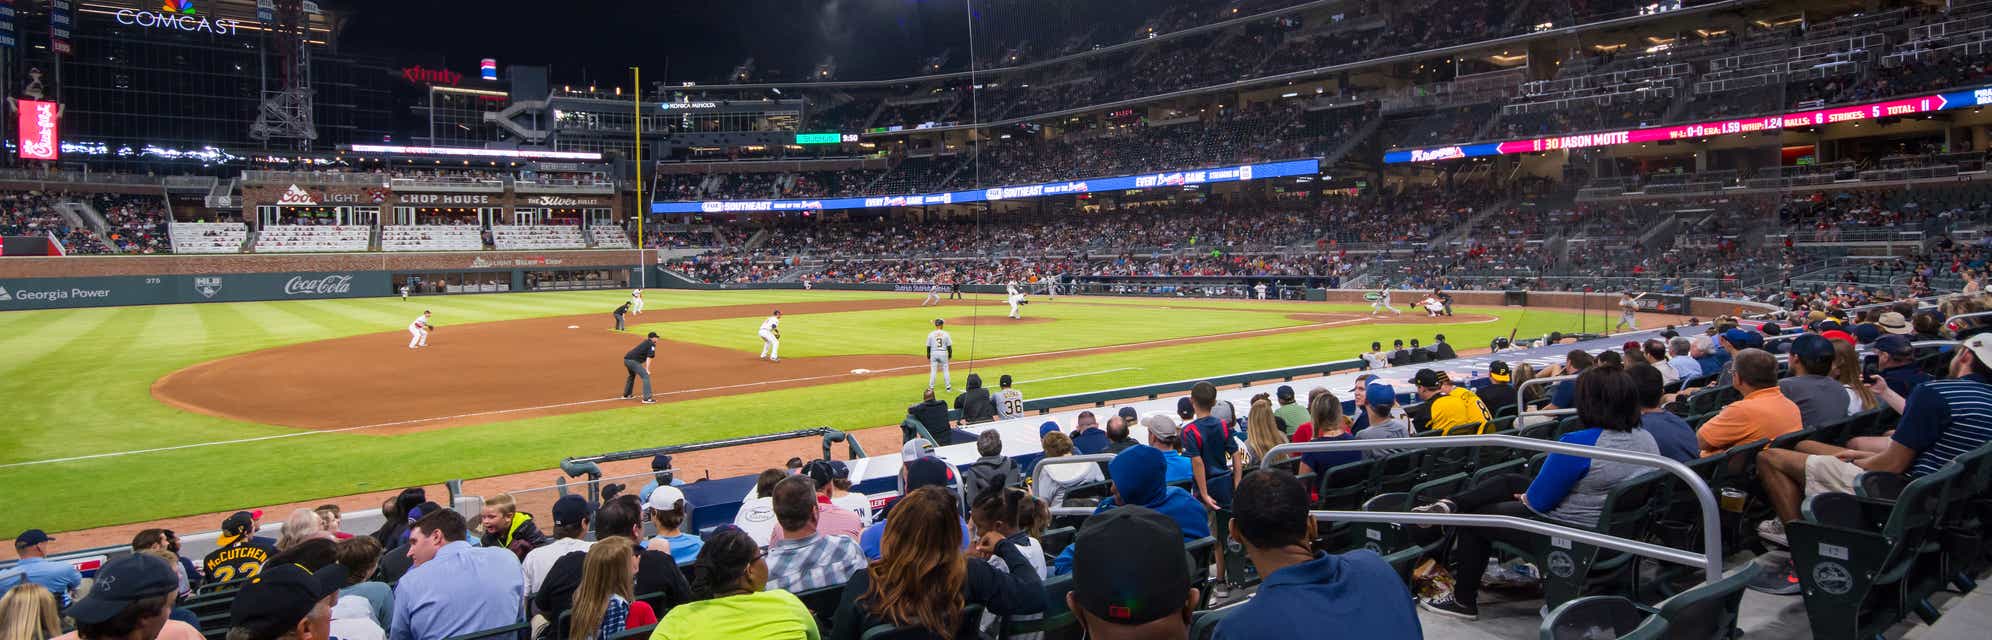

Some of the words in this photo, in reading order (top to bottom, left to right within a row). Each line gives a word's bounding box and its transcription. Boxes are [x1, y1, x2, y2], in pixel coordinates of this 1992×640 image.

[116, 10, 239, 35] COMCAST
[402, 65, 462, 86] xfinity
[1545, 137, 1559, 150] 30
[1561, 134, 1592, 149] JASON
[1593, 131, 1629, 147] MOTTE
[1687, 125, 1703, 137] 0-0
[1704, 127, 1720, 136] ERA:
[1722, 121, 1740, 134] 1.59
[1741, 122, 1764, 132] WHIP:
[1765, 118, 1782, 129] 1.24
[1784, 116, 1811, 127] BALLS:
[1816, 112, 1824, 124] 6
[1829, 111, 1865, 122] STRIKES:
[1872, 106, 1880, 117] 5
[1887, 104, 1915, 115] TOTAL:
[1921, 99, 1930, 111] 11
[842, 134, 858, 142] 9:50
[323, 193, 360, 202] LIGHT
[1003, 185, 1043, 198] SOUTHEAST
[400, 194, 438, 203] CHOP
[443, 195, 489, 204] HOUSE
[724, 201, 772, 211] SOUTHEAST
[284, 275, 353, 294] Coca-Cola
[16, 289, 68, 301] Georgia
[71, 288, 110, 298] Power
[1004, 399, 1023, 416] 36
